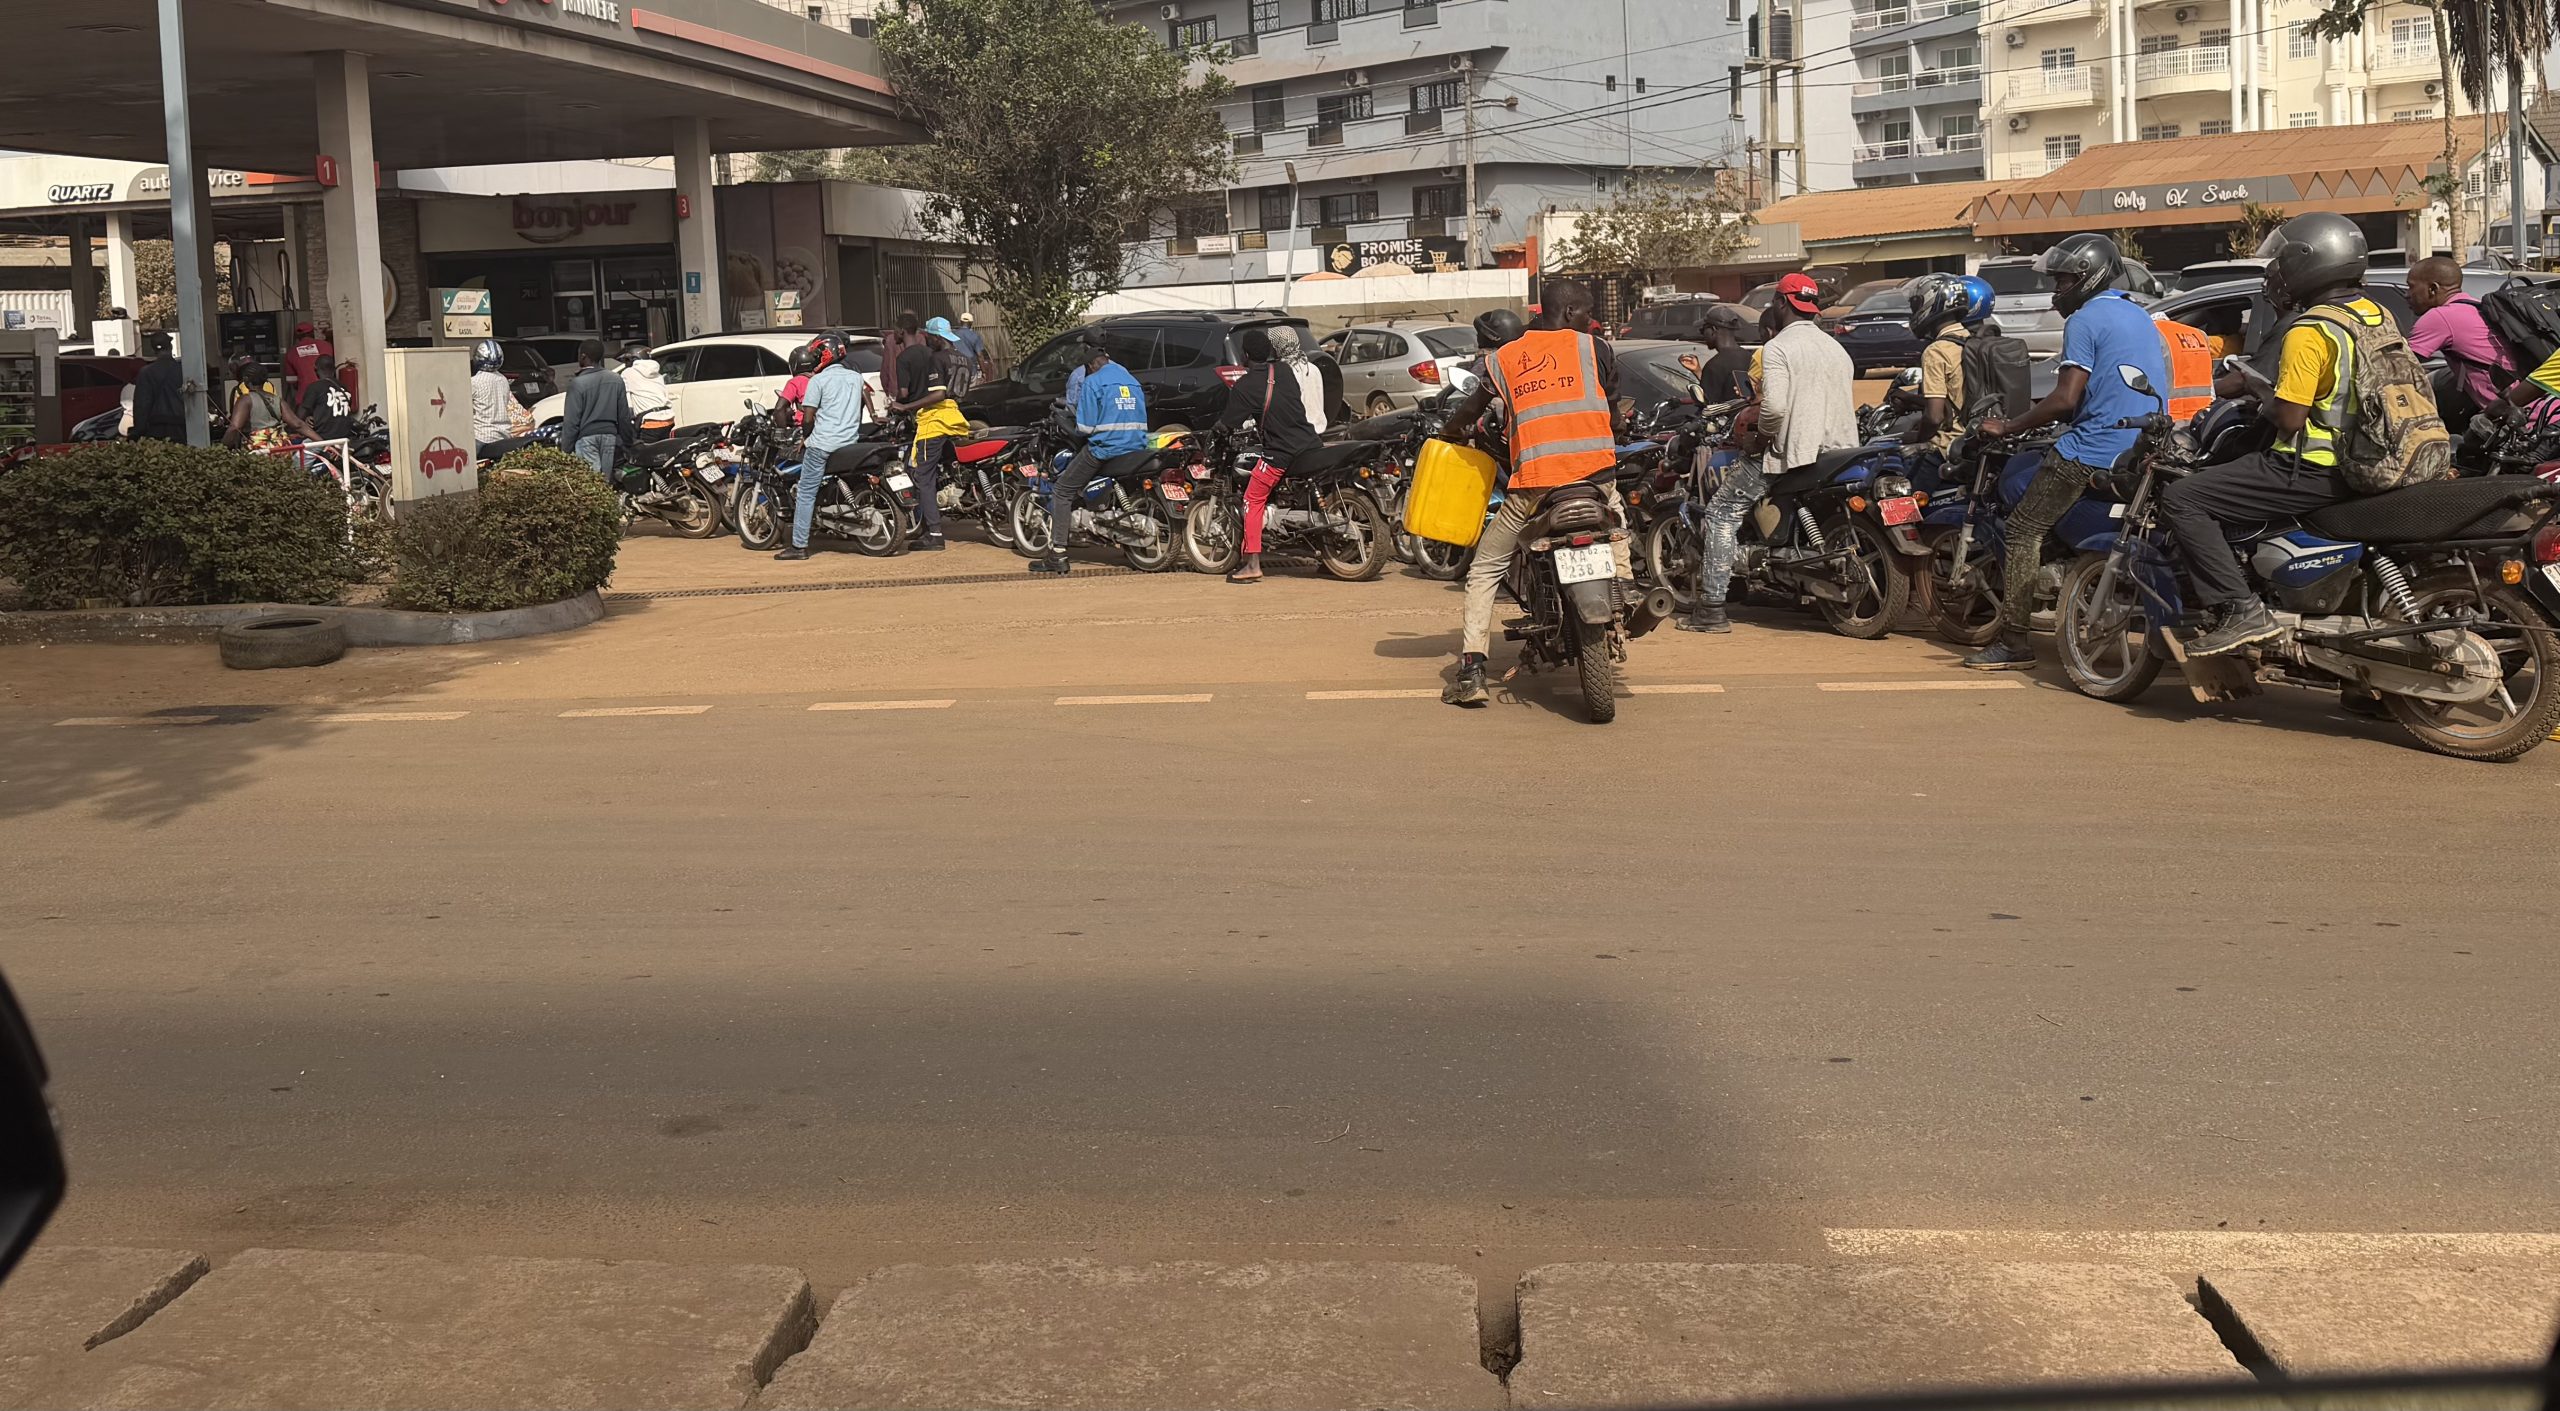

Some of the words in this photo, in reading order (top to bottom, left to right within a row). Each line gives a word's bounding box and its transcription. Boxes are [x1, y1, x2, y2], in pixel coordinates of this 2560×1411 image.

[323, 160, 331, 180] 1
[140, 173, 171, 190] aut
[208, 169, 241, 186] vice
[48, 184, 113, 201] QUARTZ
[2201, 184, 2249, 203] Snack
[681, 198, 688, 214] 3
[512, 198, 637, 236] bonjour
[1360, 239, 1423, 256] PROMISE
[1361, 253, 1423, 268] BOQUE
[1558, 376, 1575, 388] TP
[1569, 563, 1595, 579] 238
